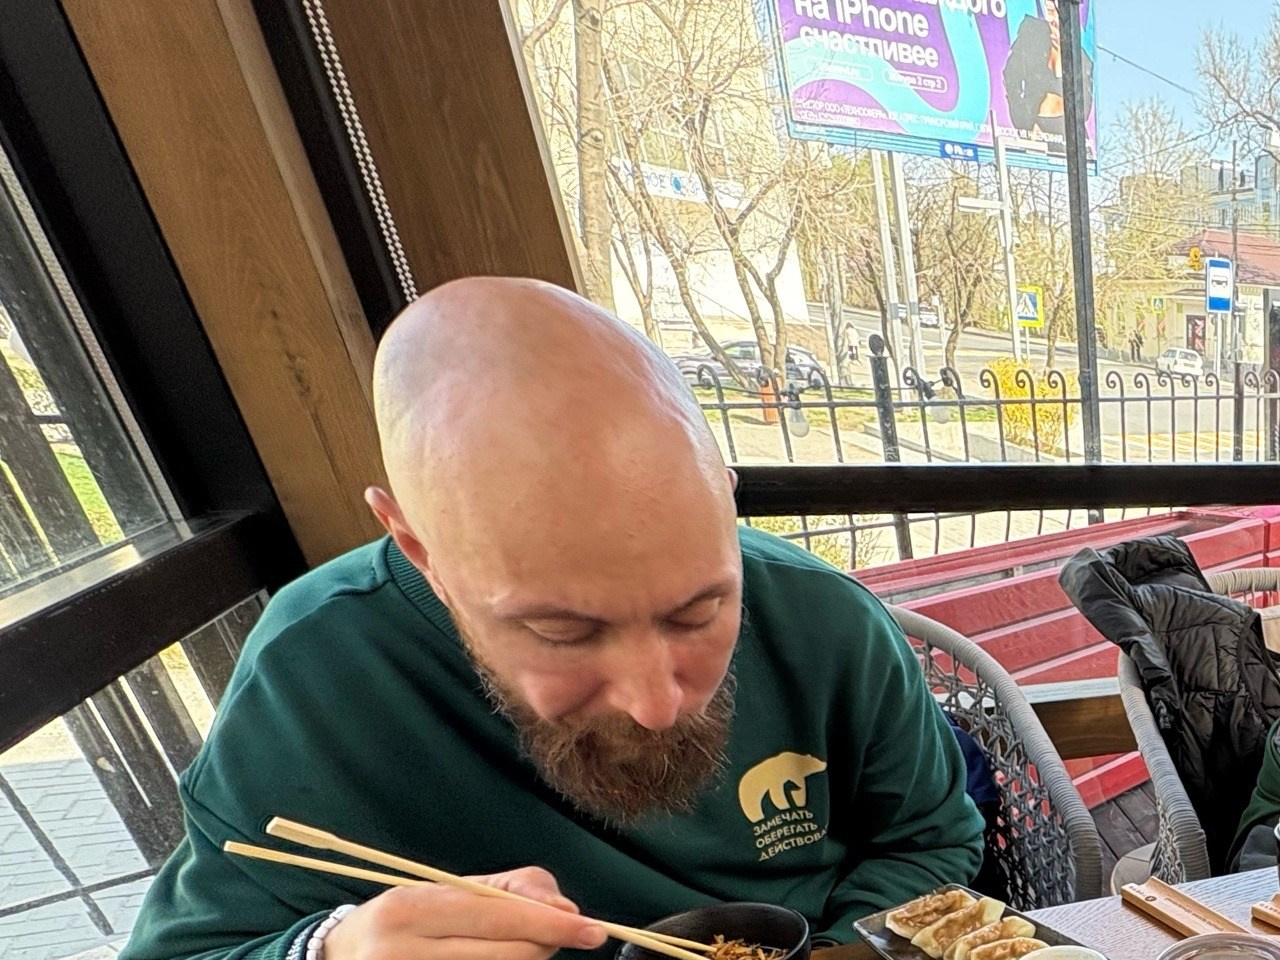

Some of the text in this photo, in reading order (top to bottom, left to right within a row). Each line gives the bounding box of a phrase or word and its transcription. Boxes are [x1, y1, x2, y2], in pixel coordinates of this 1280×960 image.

[794, 0, 930, 38] на iPhone
[799, 25, 939, 69] счастливее
[753, 810, 814, 836] ЗАМЕЧАТЬ
[756, 822, 819, 849] ОБЕРЕГАТЬ
[758, 829, 828, 862] ДЕЙСТВОВА
